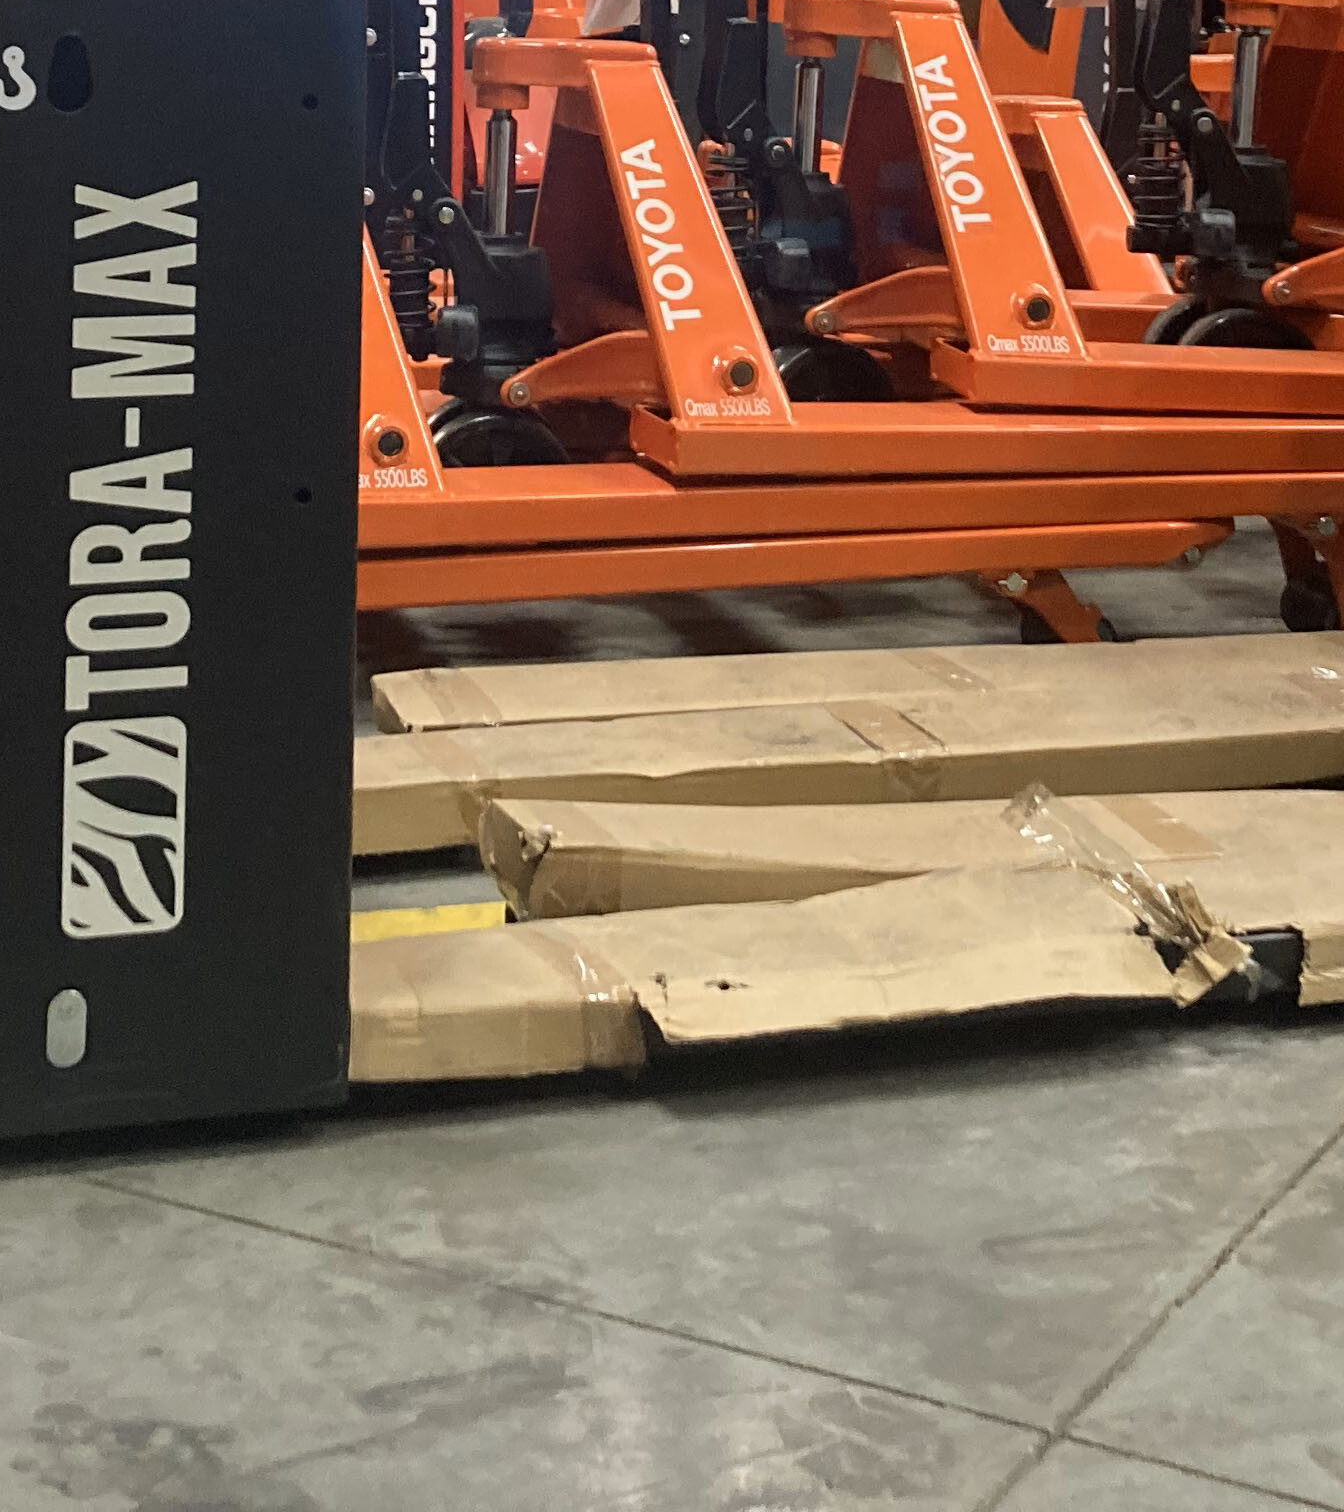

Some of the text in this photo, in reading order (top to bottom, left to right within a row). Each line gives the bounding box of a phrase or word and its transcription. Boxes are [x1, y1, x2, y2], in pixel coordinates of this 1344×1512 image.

[621, 139, 701, 331] TOYOTA
[914, 55, 991, 233] TOYOTA
[65, 180, 199, 712] TORA-MAX
[374, 467, 428, 489] 5500LBS
